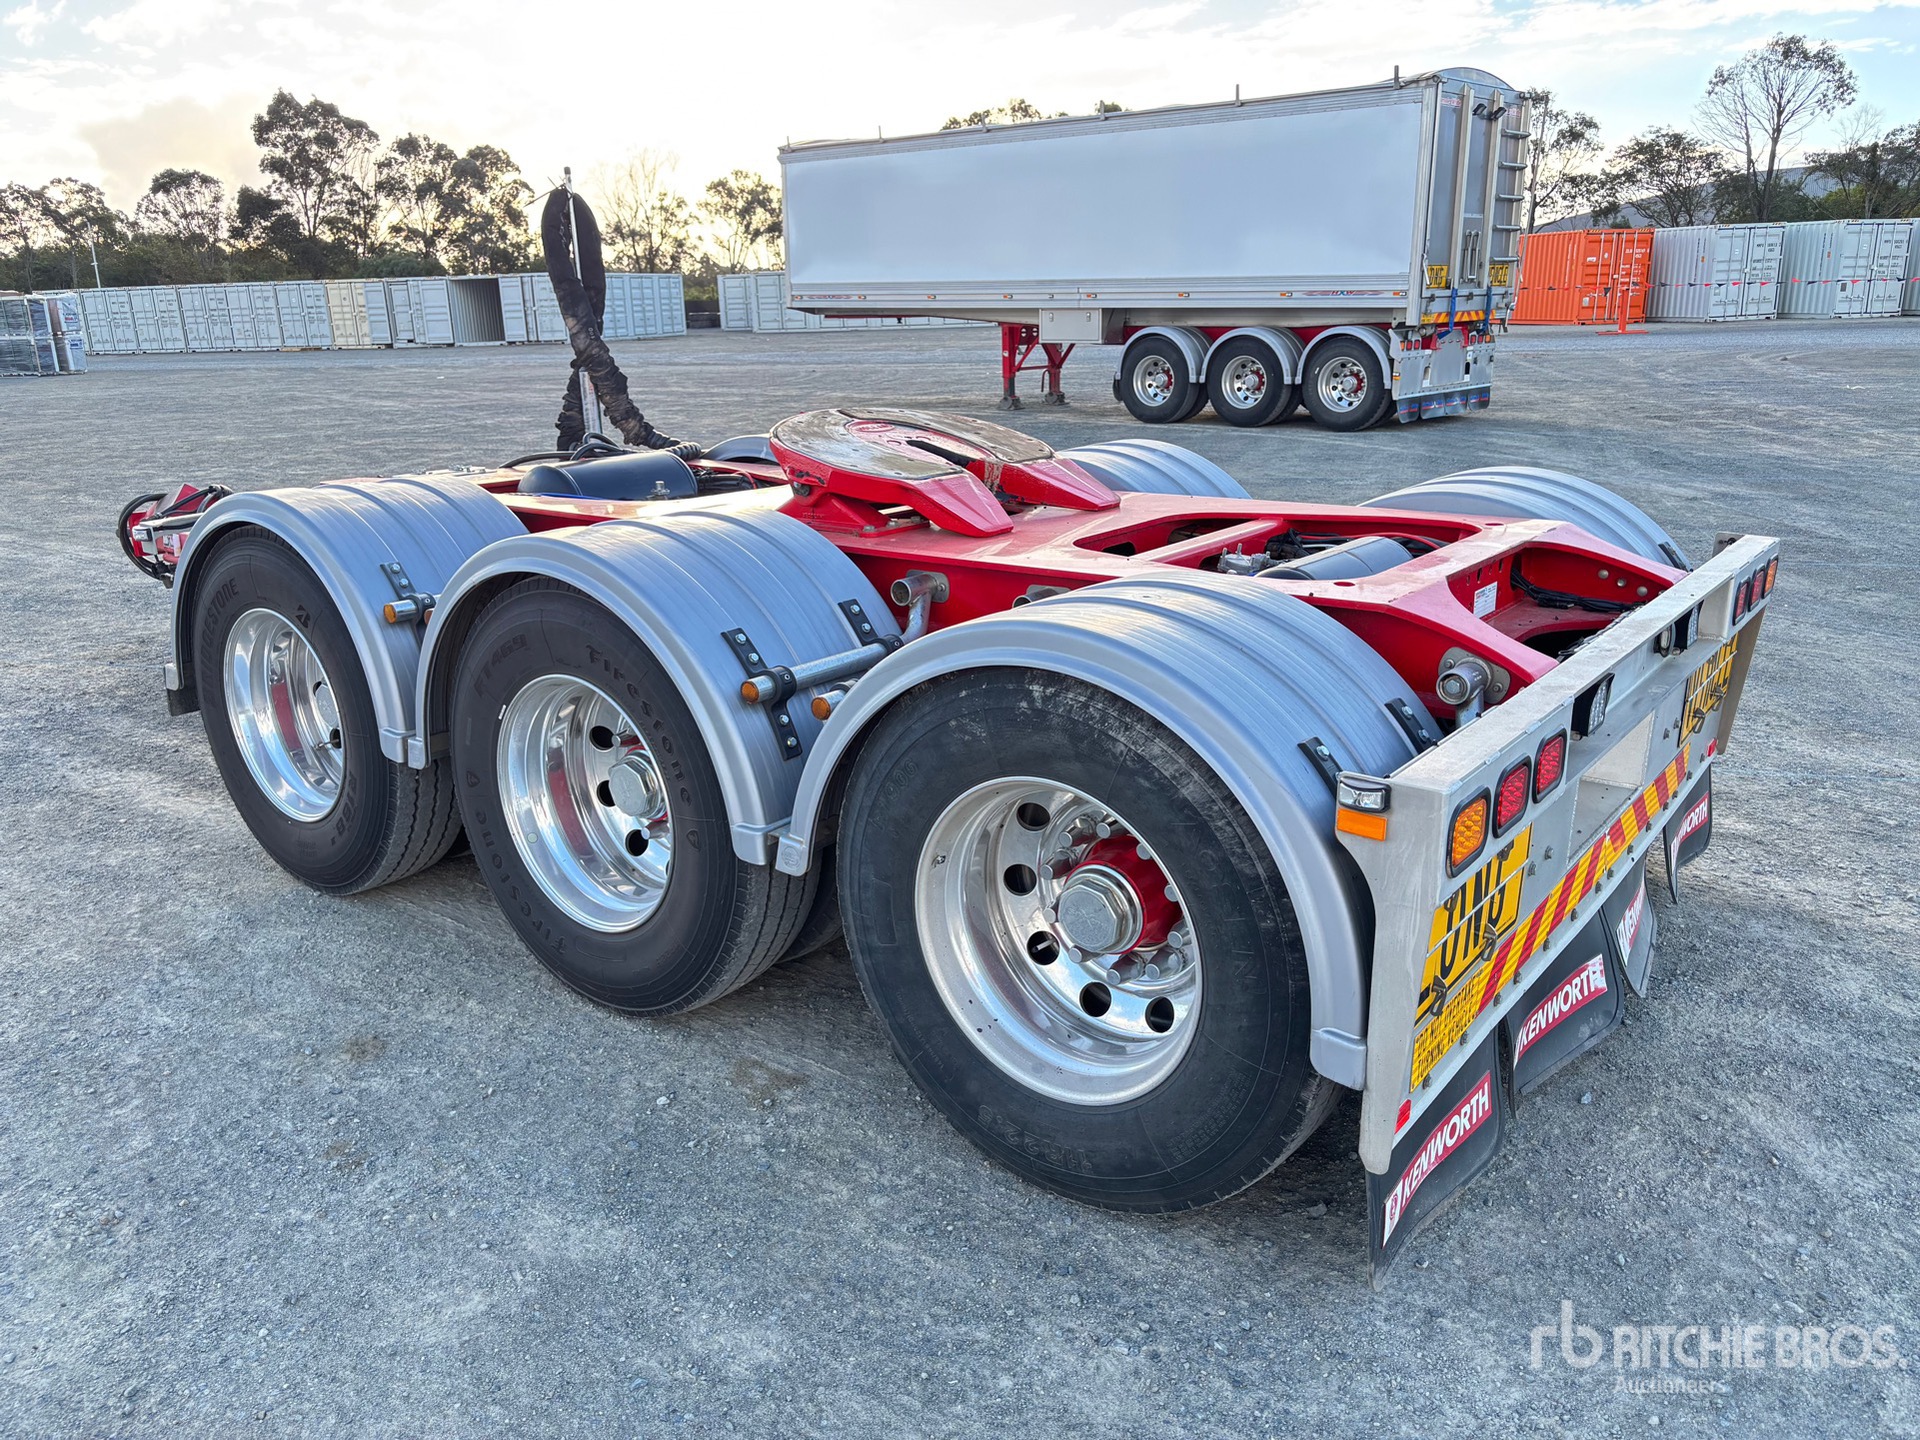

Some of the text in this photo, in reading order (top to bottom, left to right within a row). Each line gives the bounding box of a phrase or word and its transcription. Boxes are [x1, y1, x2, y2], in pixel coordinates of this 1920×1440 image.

[586, 644, 693, 808] Firestone
[1418, 858, 1506, 1007] ONG
[1402, 1081, 1489, 1206] KENWORTH
